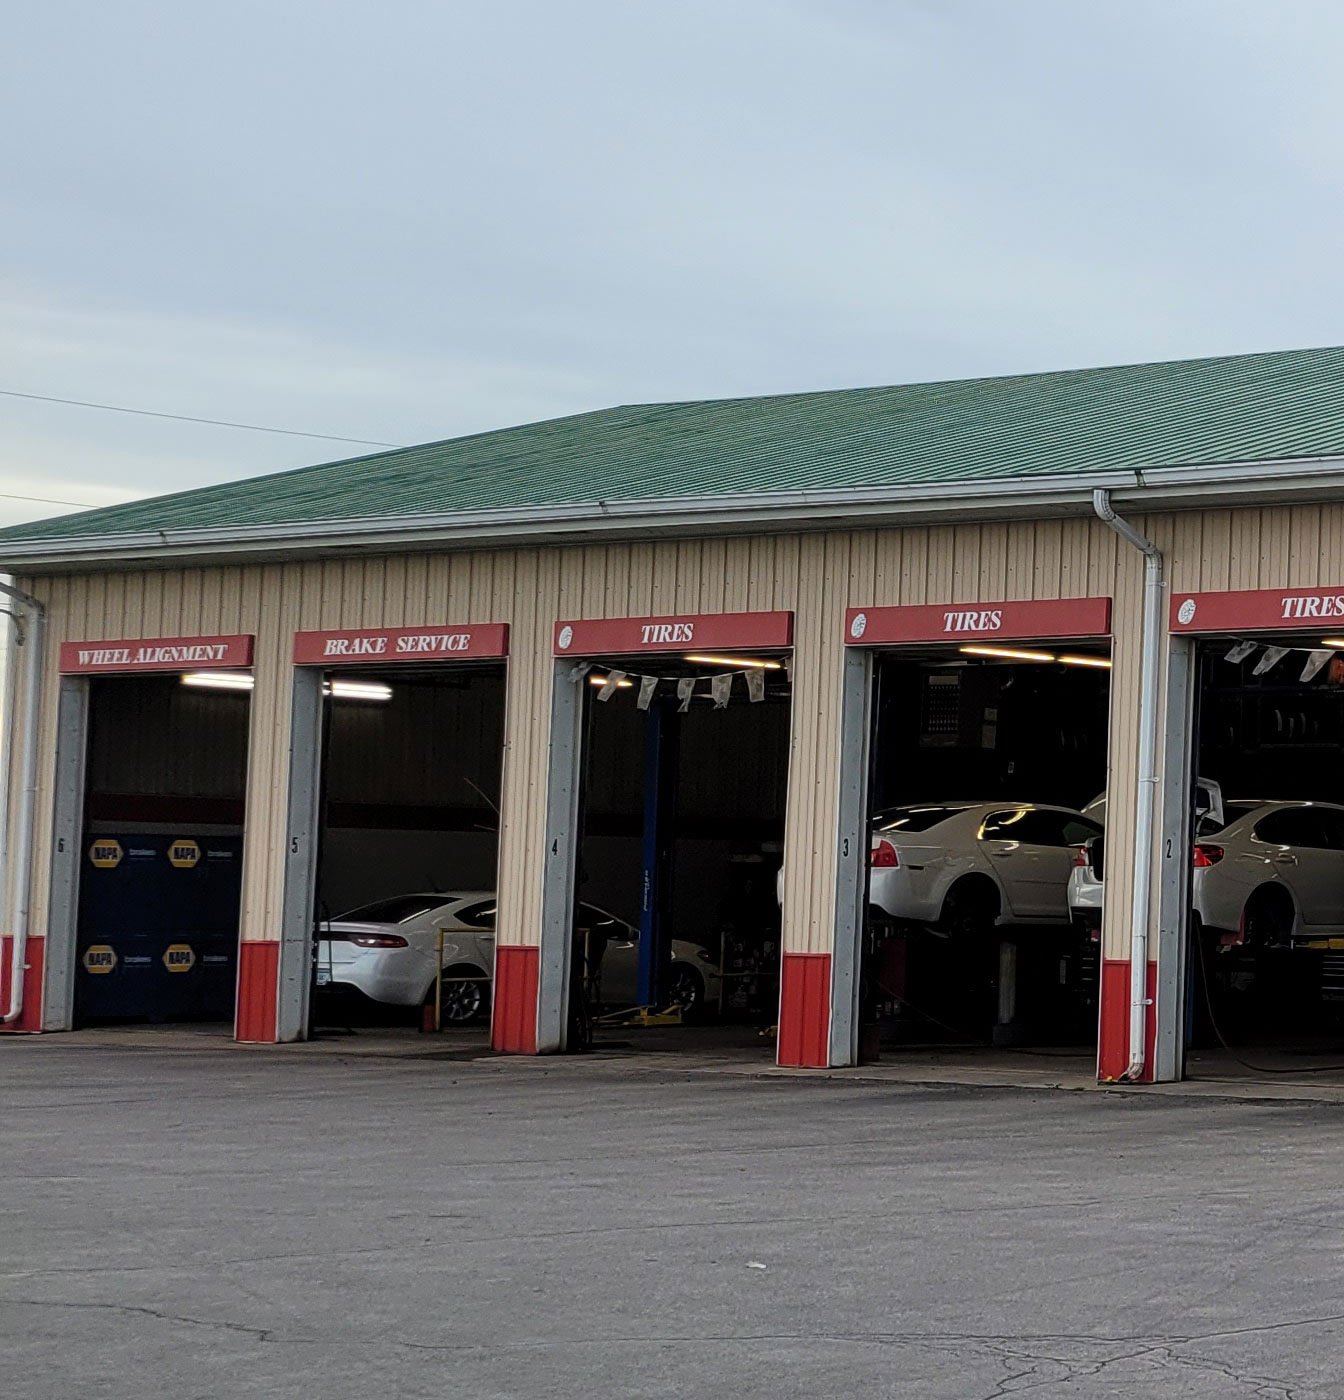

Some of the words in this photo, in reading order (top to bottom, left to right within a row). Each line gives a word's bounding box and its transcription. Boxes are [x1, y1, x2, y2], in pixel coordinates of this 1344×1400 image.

[943, 610, 1003, 632] TIRES
[641, 623, 694, 643] TIRES
[78, 648, 131, 665] WHEEL
[132, 644, 228, 664] ALIGNMENT
[323, 637, 388, 656] BRAKE
[396, 634, 471, 653] SERVICE
[291, 837, 298, 854] 5
[552, 839, 558, 855] 4
[843, 838, 849, 857] 3
[1166, 839, 1172, 858] 2
